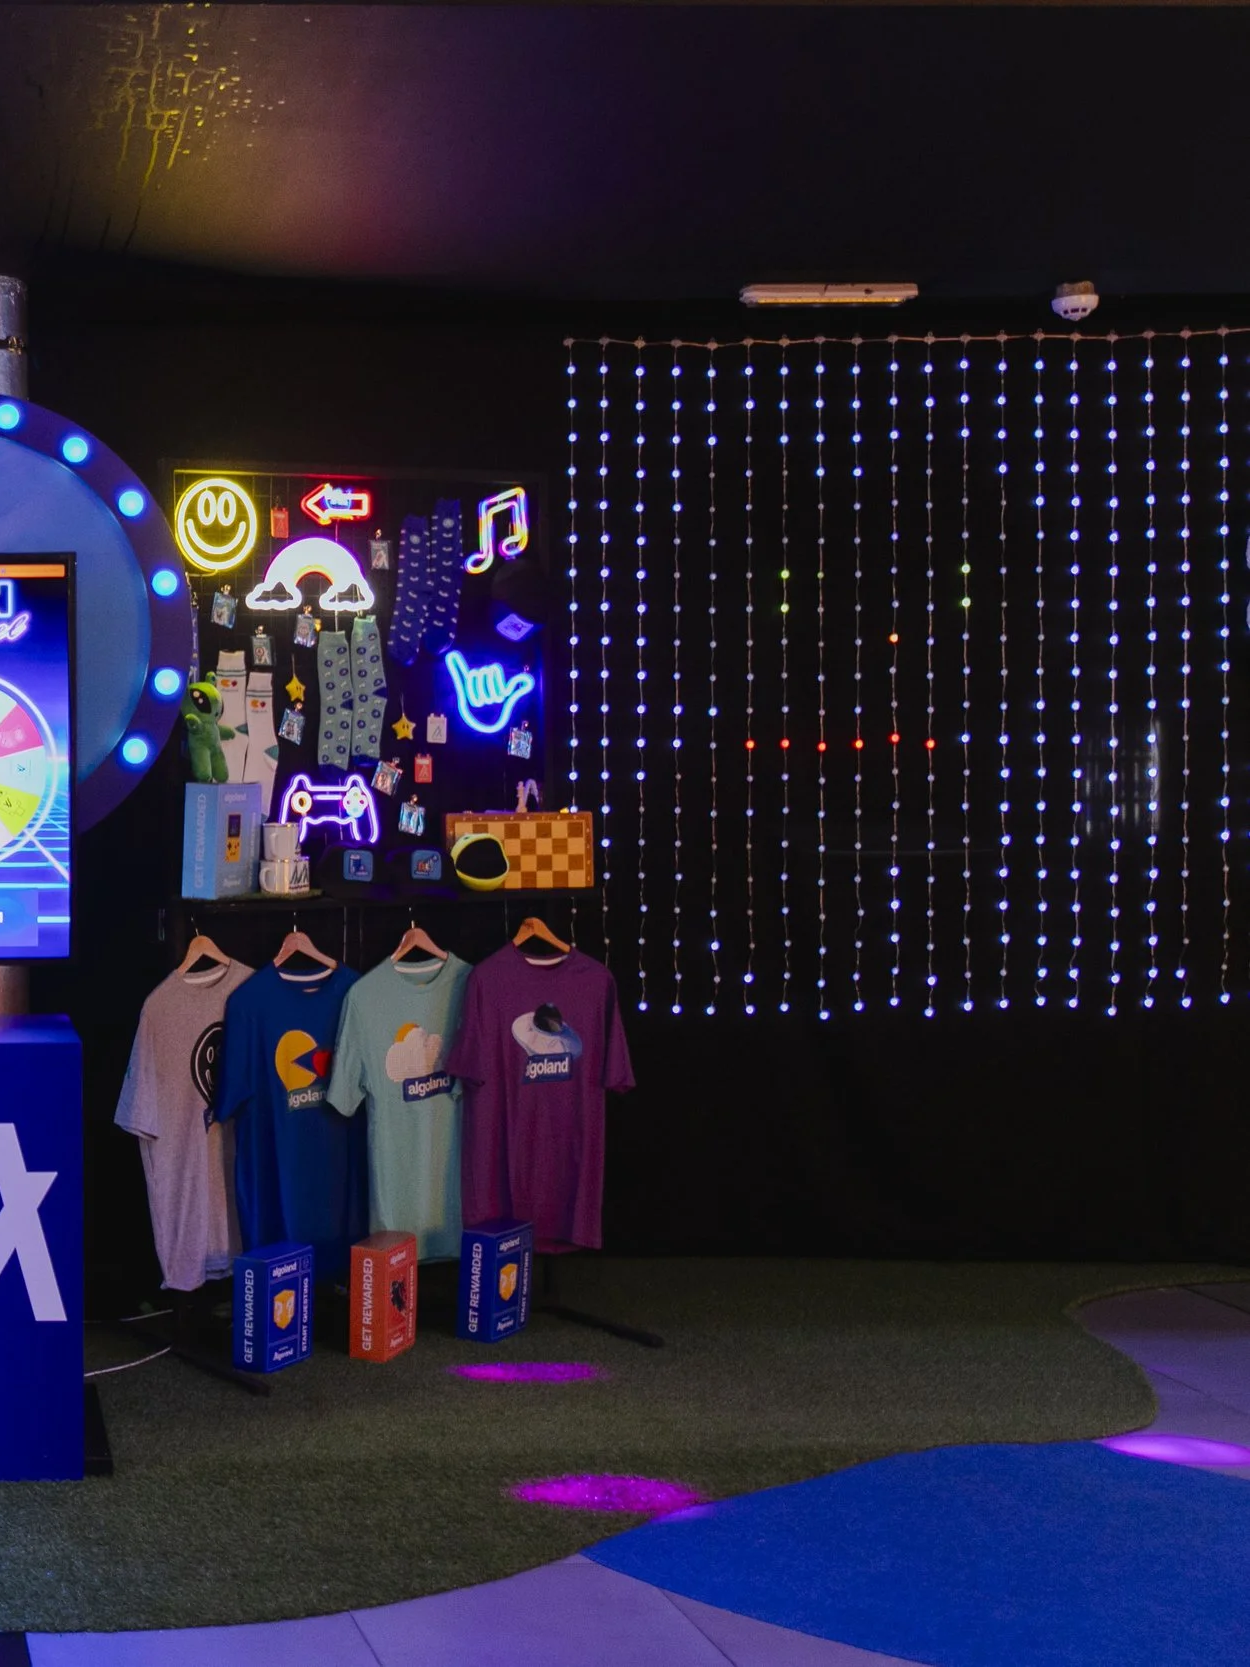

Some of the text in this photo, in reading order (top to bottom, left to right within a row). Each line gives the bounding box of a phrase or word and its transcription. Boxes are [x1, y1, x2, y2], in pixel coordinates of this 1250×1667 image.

[244, 1269, 254, 1363] GET REWARDED
[362, 1258, 373, 1351] GET REWARDED
[468, 1243, 483, 1333] GET REWARDED
